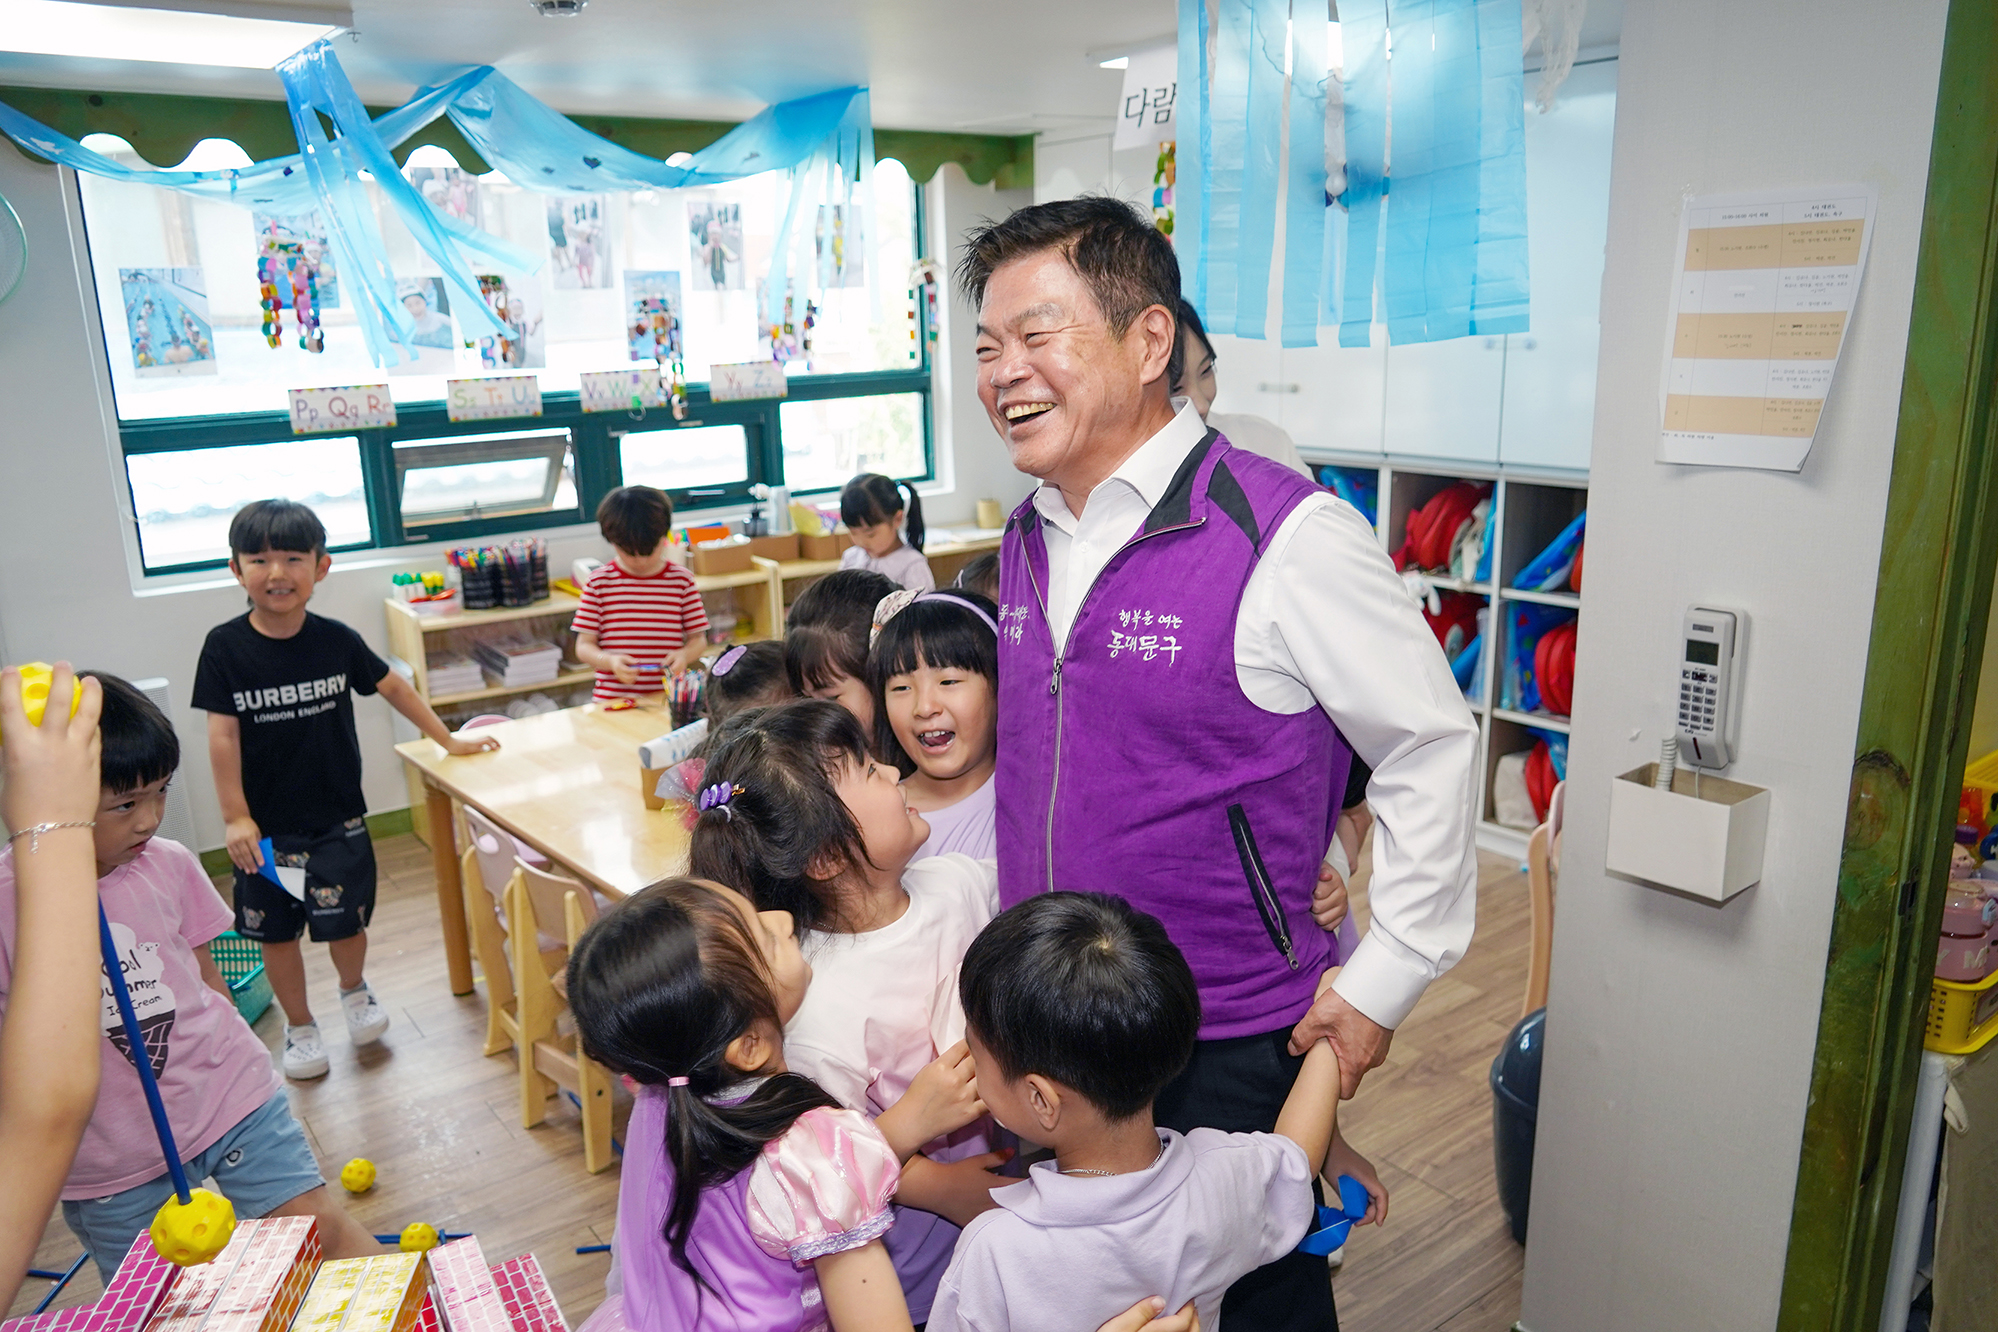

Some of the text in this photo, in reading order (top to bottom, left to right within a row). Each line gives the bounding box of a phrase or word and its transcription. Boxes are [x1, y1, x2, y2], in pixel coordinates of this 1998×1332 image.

[295, 398, 319, 422] Pp
[328, 396, 359, 419] Qq
[1119, 609, 1183, 631] 행복을 여는
[1107, 630, 1182, 668] 동대문구
[232, 673, 347, 712] BURBERRY
[254, 709, 296, 724] LONDON
